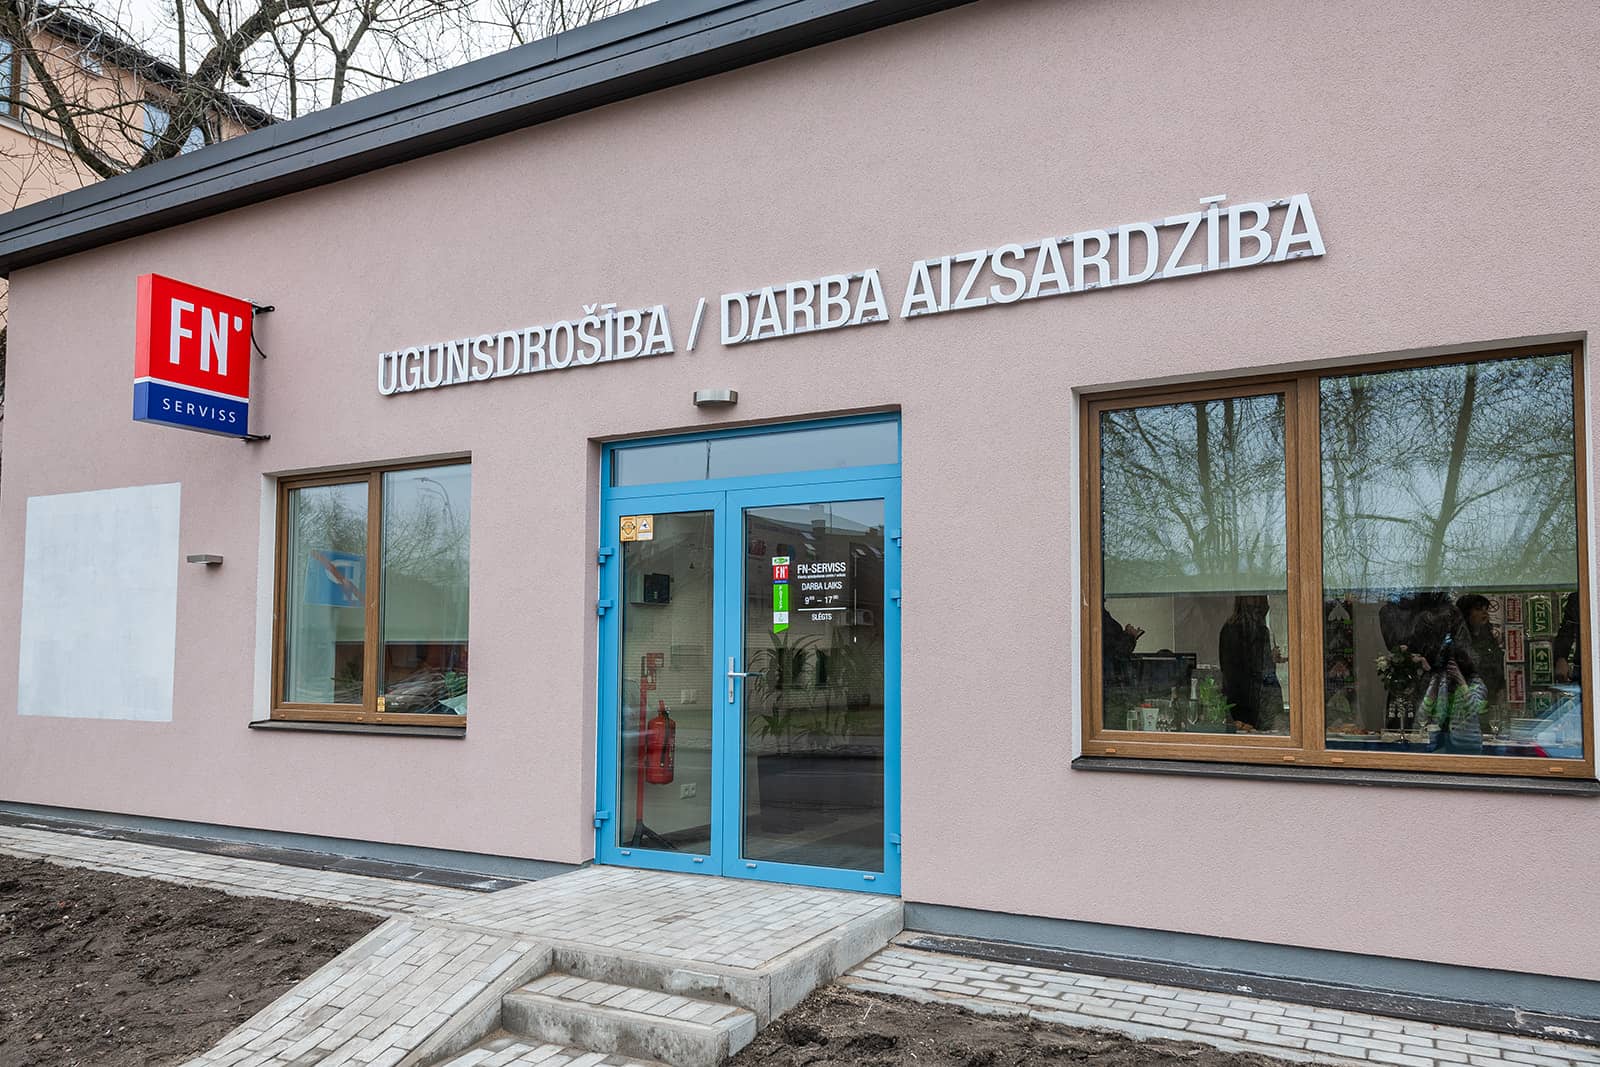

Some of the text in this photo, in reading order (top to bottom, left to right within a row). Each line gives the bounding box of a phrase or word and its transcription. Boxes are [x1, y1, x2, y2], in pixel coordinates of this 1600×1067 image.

[378, 193, 1326, 395] UGUNSDROŠĪBA / DARBA AIZSARDZĪBA
[162, 398, 236, 423] SERVISS
[797, 562, 846, 574] FN-SERVISS
[801, 581, 842, 590] DARBA LAIKS
